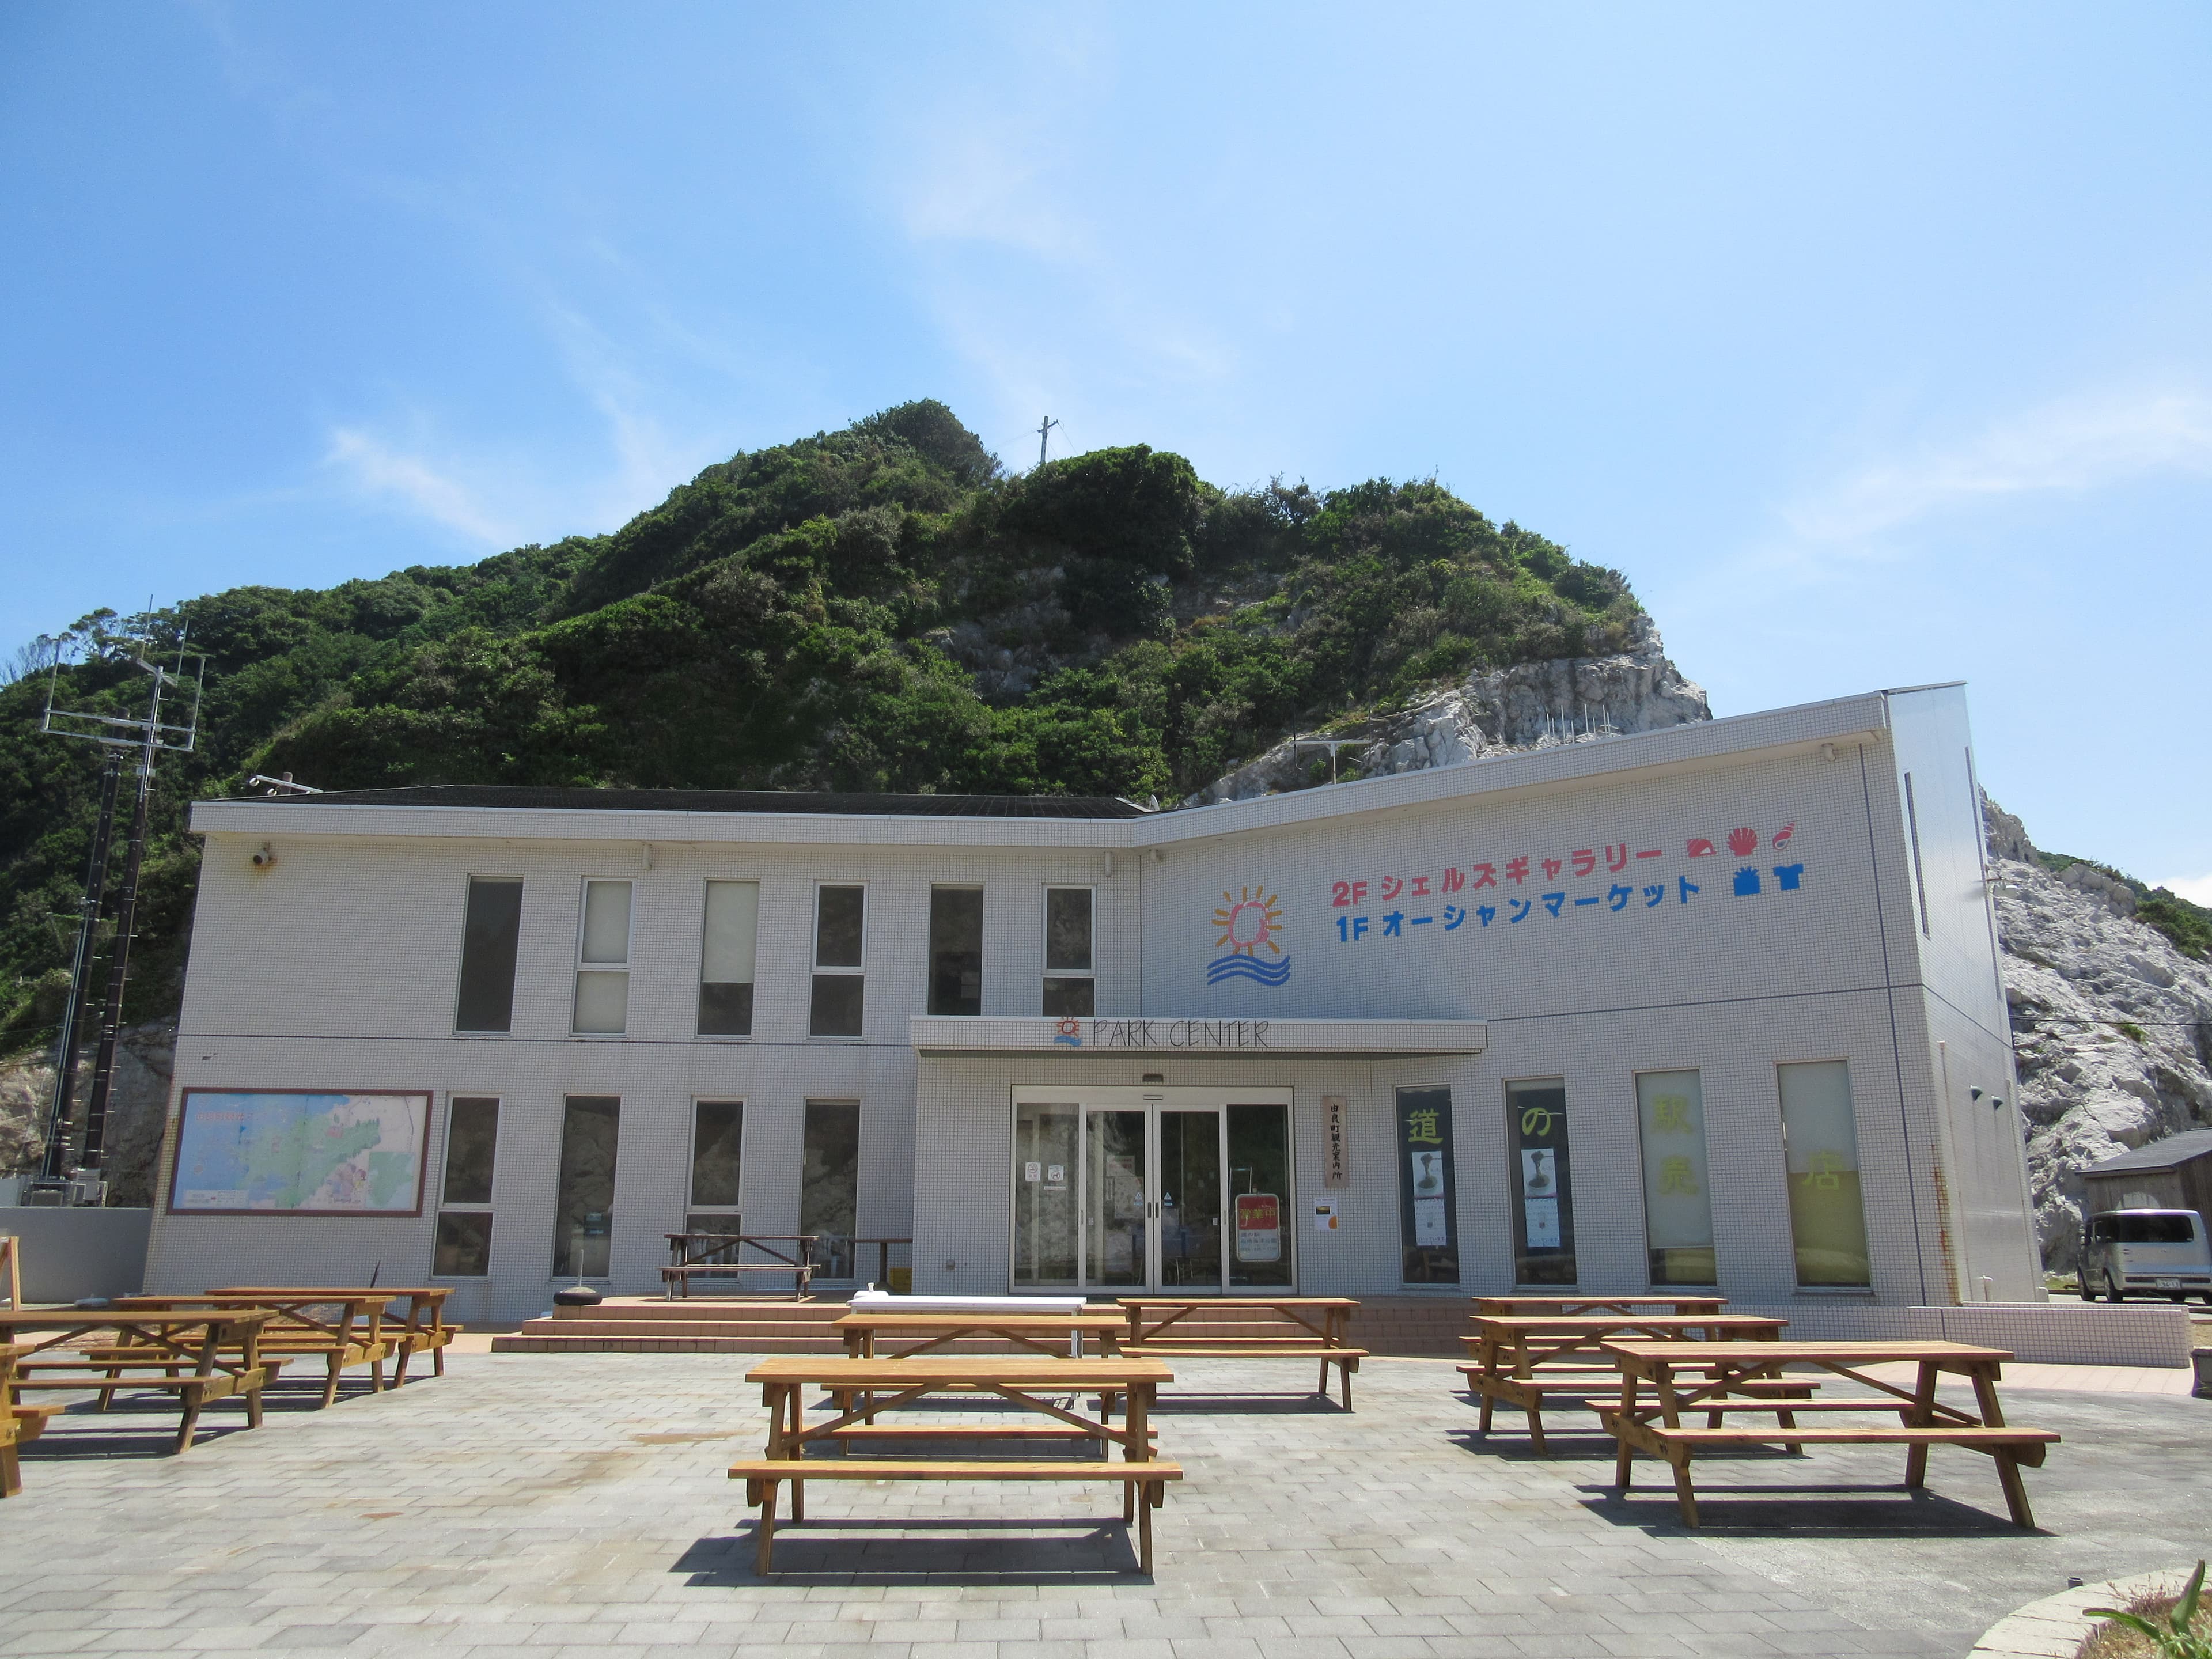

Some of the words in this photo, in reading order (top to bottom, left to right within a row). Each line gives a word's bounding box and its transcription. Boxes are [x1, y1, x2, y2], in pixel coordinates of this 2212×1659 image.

[1332, 881, 1368, 907] 2F
[1336, 916, 1368, 942] 1F
[1382, 875, 1699, 937] オーシャンマーケット
[1093, 1018, 1158, 1047] PARK
[1169, 1020, 1269, 1047] CENTER
[1330, 1103, 1343, 1180] 由良町観光案内所
[1240, 1207, 1277, 1219] 営業中
